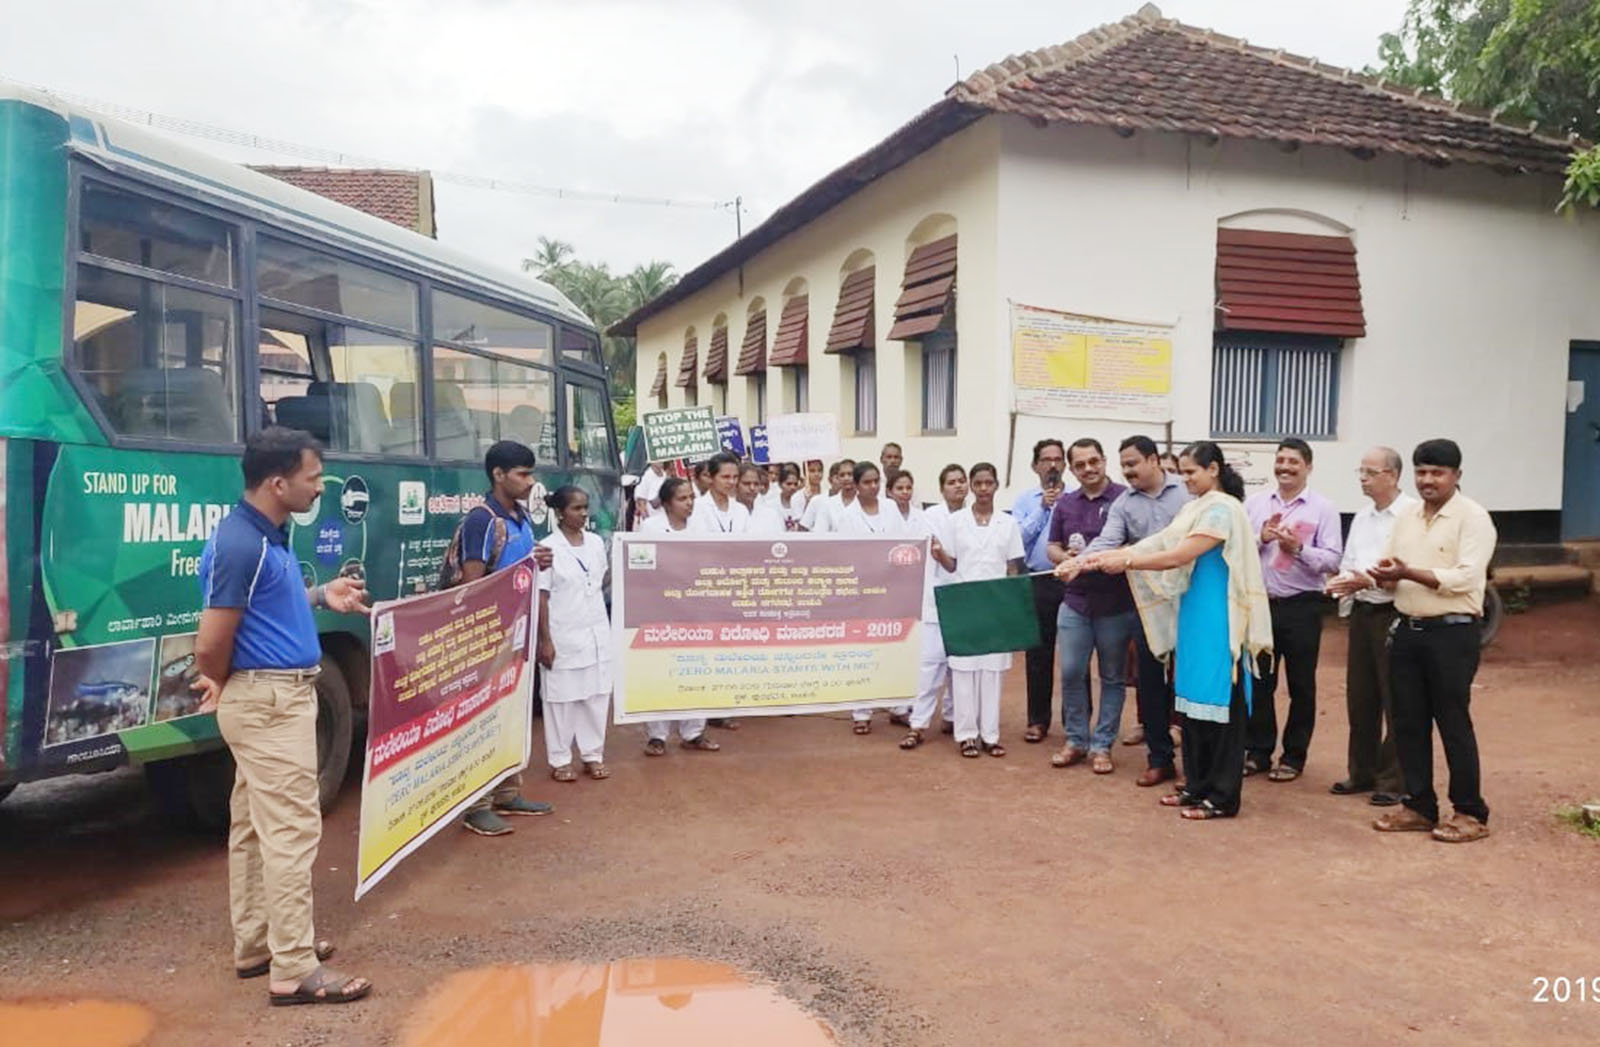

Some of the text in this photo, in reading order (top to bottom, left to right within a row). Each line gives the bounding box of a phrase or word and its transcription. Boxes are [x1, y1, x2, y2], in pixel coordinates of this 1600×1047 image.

[648, 409, 710, 425] STOP THE
[649, 420, 713, 436] HYSTERIA
[651, 434, 685, 447] STOP
[689, 430, 714, 442] THE
[655, 442, 714, 458] MALARIA
[83, 471, 177, 496] STAND UP FOR
[123, 502, 238, 543] MALAR
[866, 621, 903, 638] 2019
